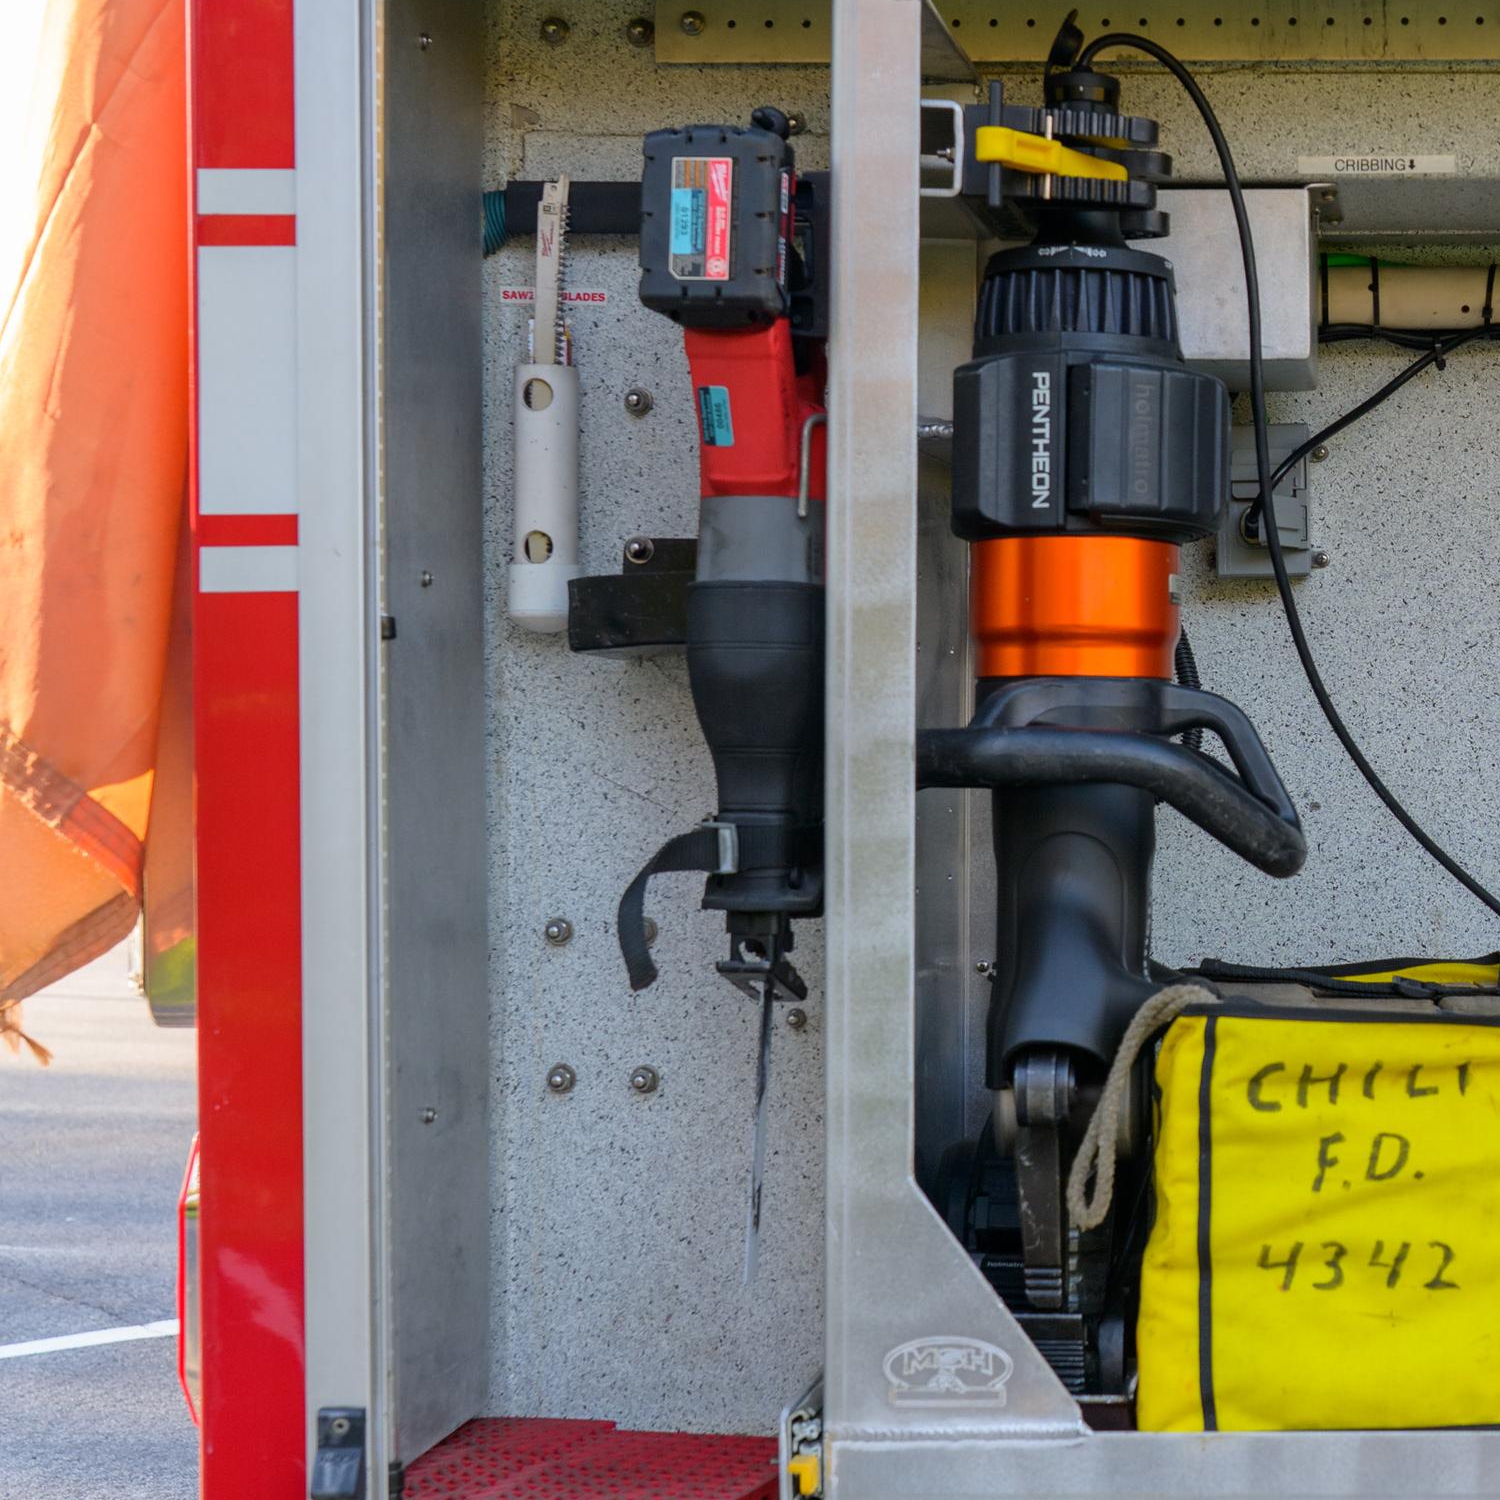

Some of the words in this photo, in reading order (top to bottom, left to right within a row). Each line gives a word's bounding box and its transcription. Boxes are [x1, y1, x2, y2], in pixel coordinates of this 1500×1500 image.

[1334, 158, 1406, 172] CRIBBING
[1031, 371, 1051, 509] PENTHEON
[1135, 384, 1155, 494] holmatro
[1246, 1060, 1473, 1112] CHILI
[1311, 1131, 1424, 1193] F.D.
[1256, 1239, 1461, 1292] 4342
